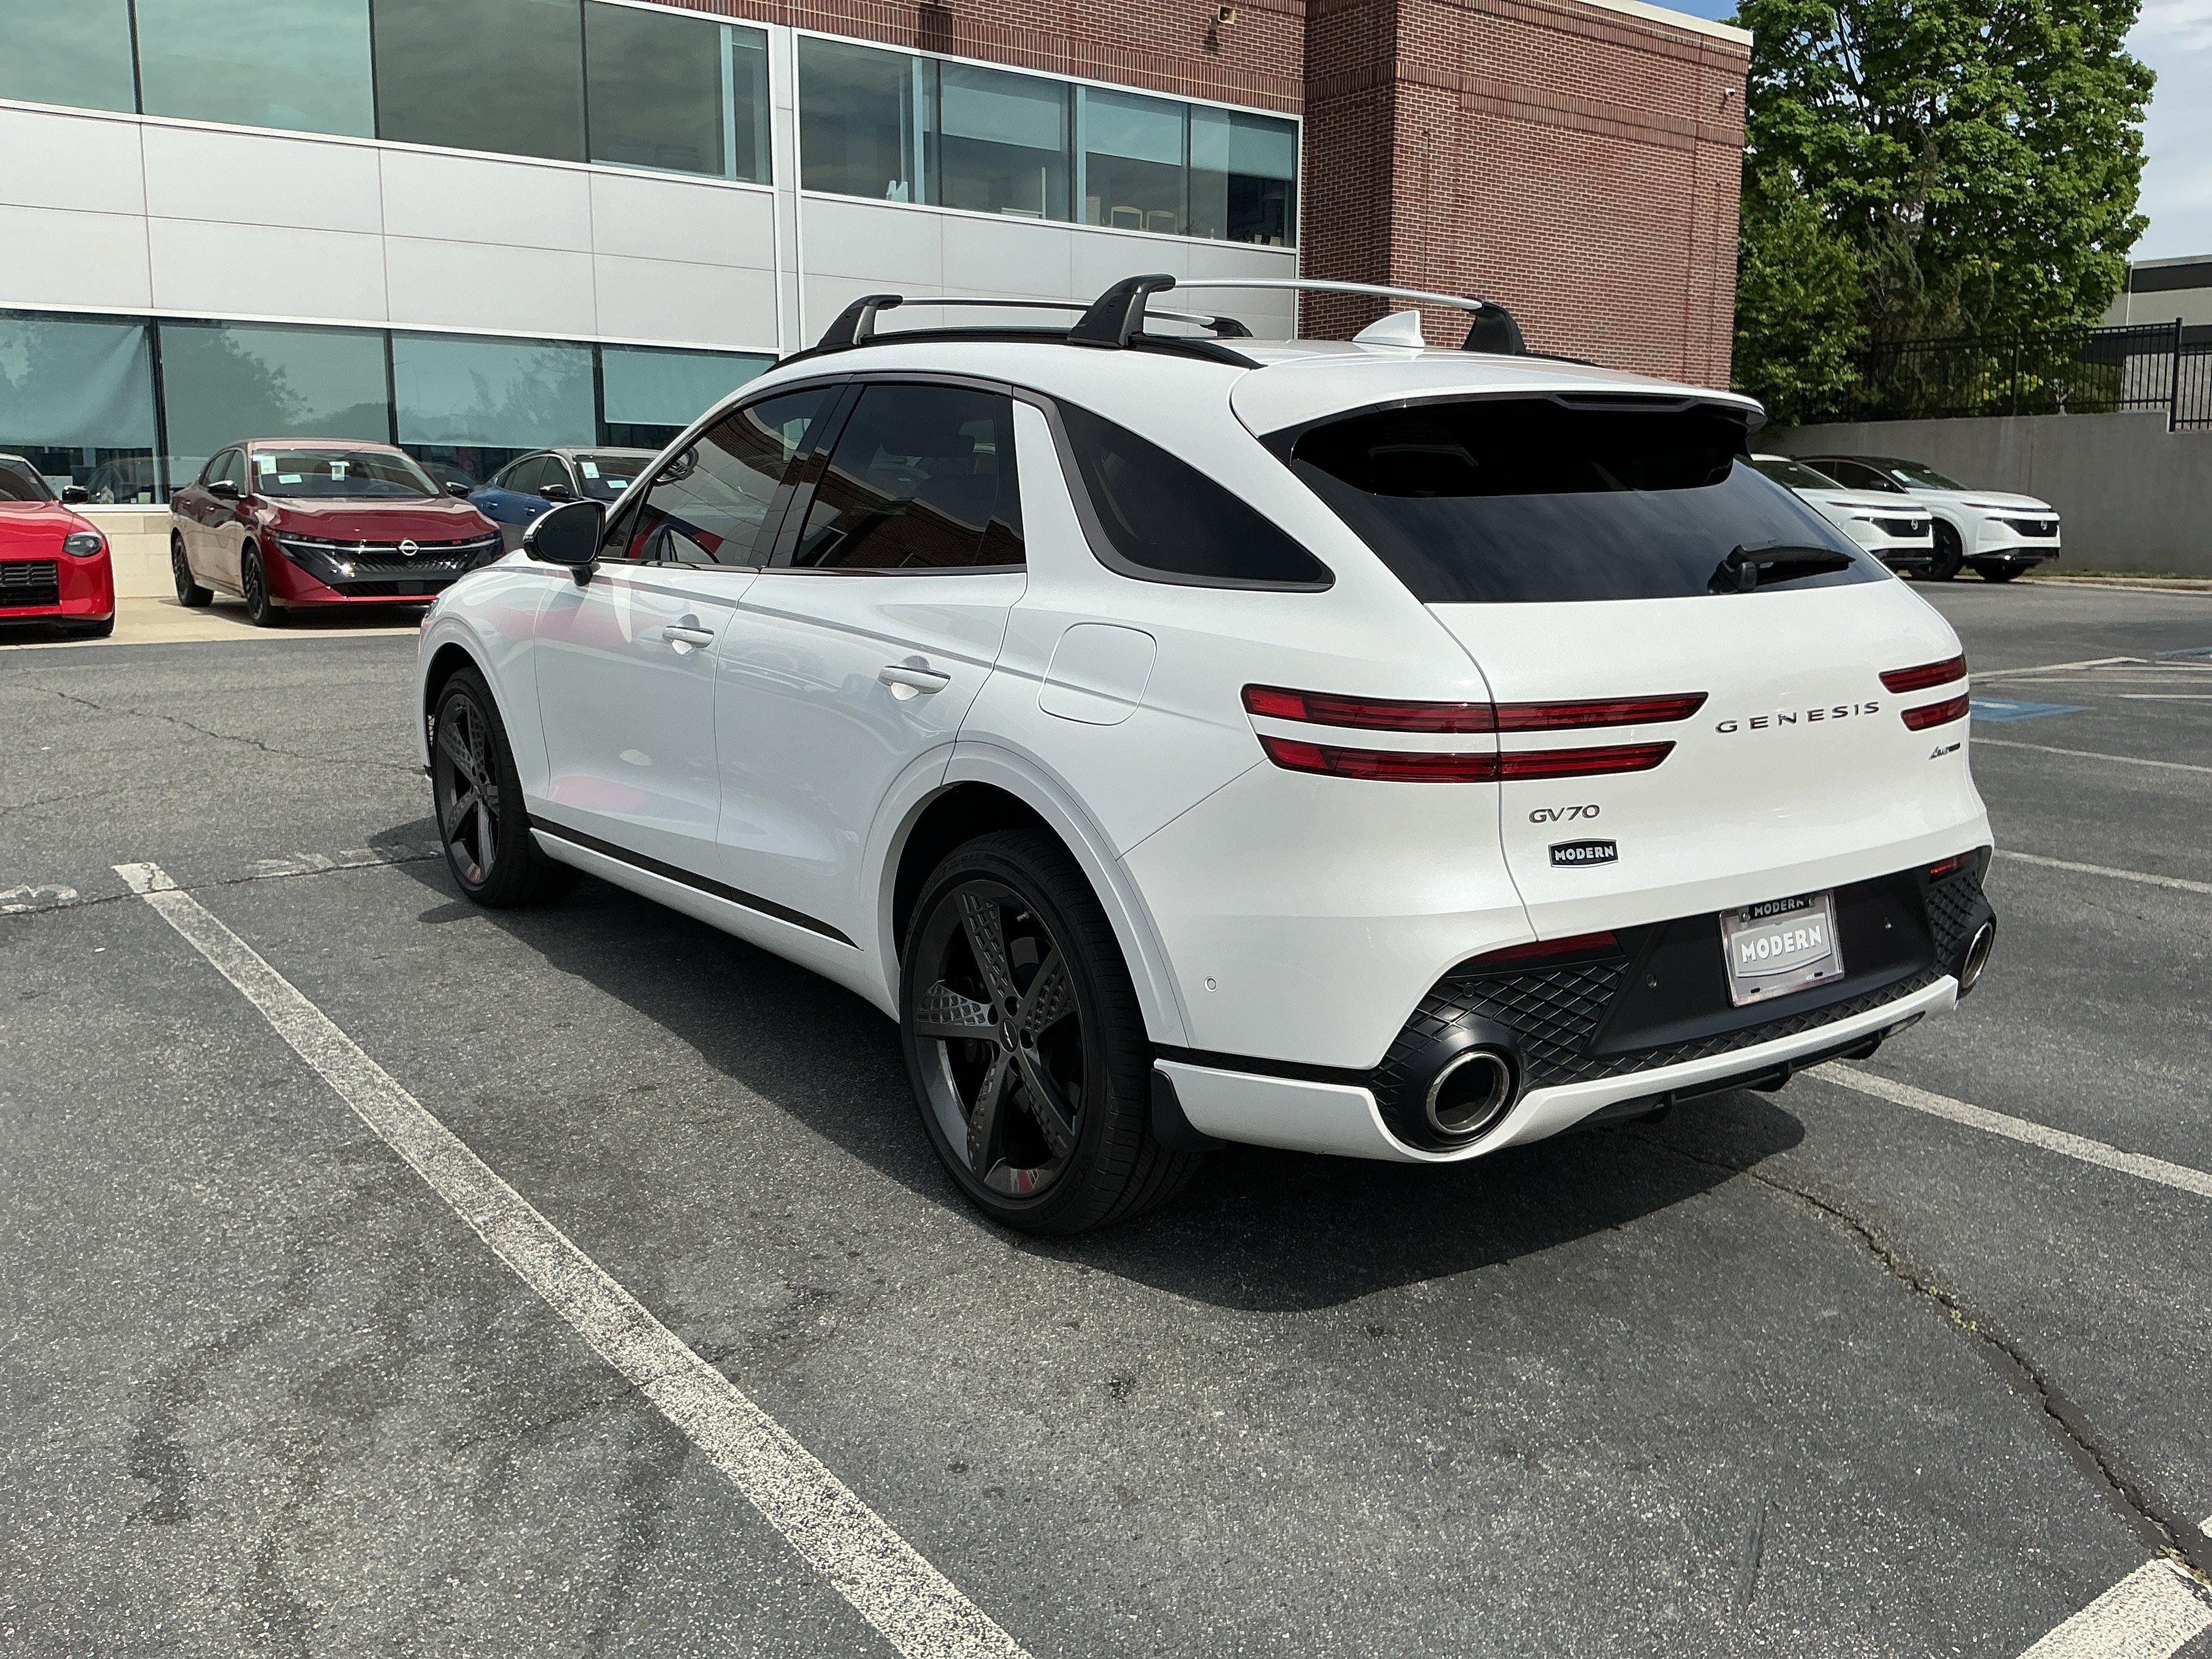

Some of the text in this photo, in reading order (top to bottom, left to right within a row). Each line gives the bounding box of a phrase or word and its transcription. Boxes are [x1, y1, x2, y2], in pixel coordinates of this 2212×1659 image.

[1715, 701, 1879, 733] GENESIS
[1528, 804, 1600, 823] GV70
[1554, 845, 1614, 861] MODERN
[1741, 926, 1822, 963] MODERN
